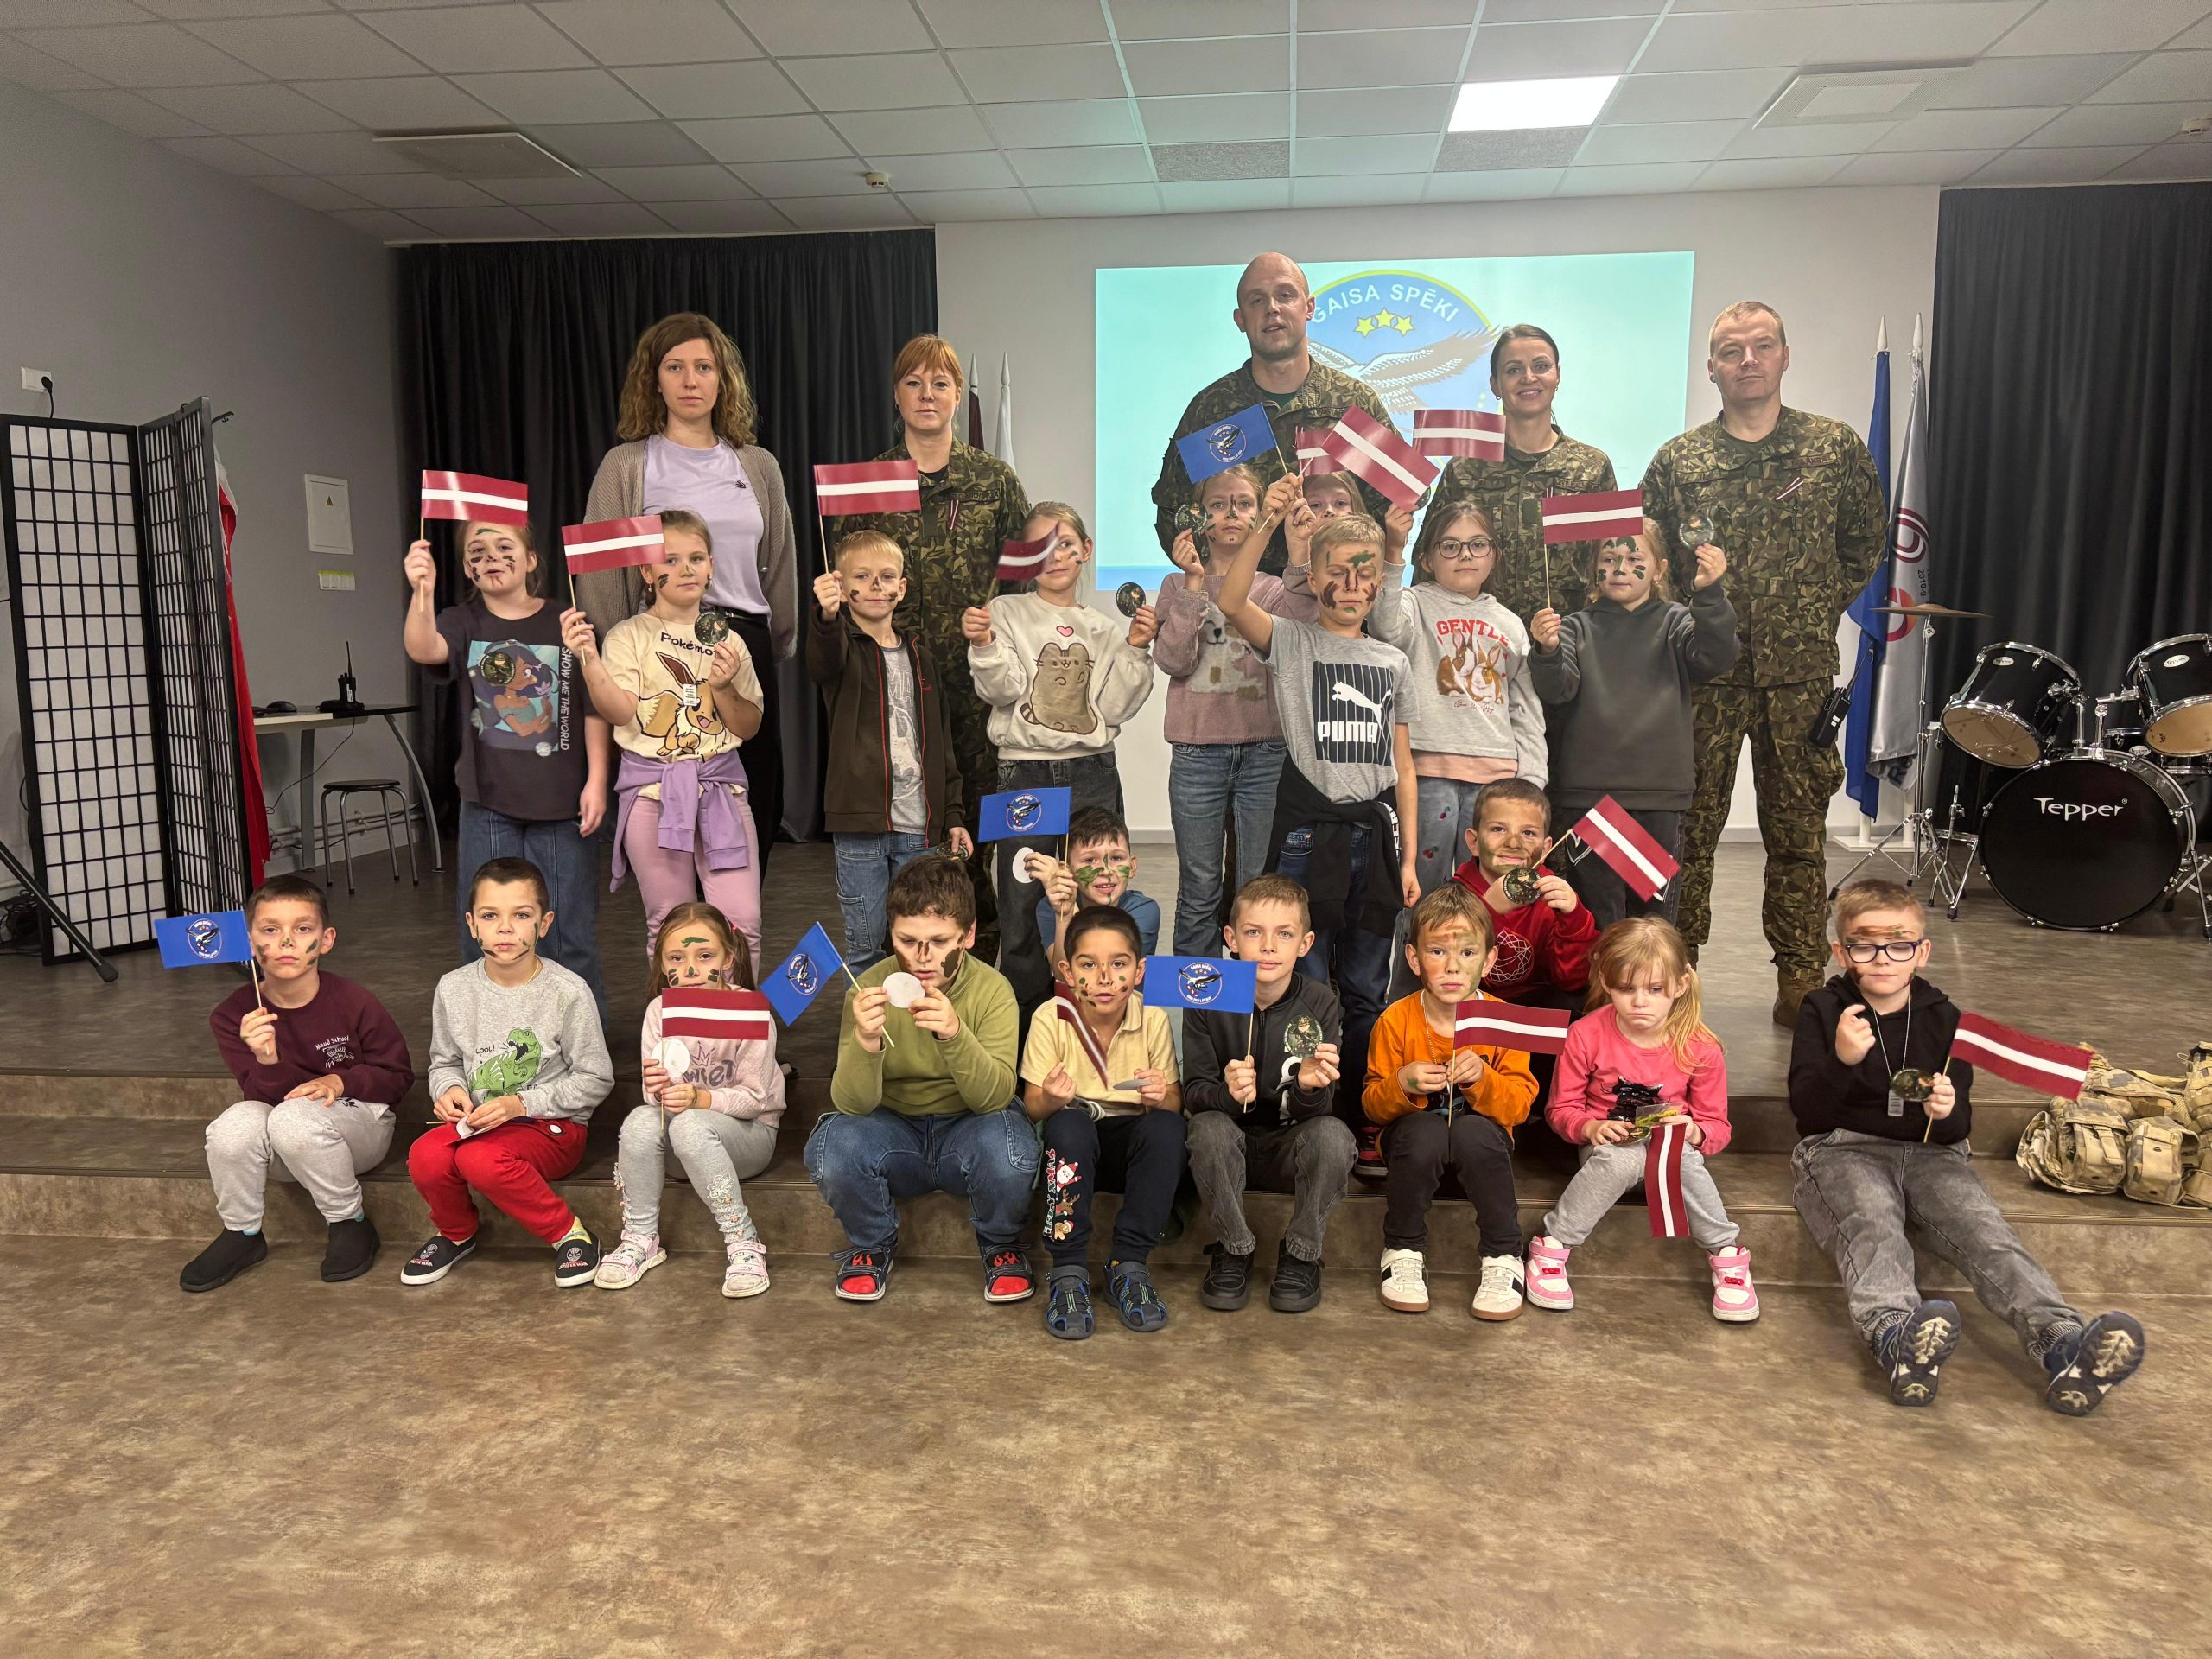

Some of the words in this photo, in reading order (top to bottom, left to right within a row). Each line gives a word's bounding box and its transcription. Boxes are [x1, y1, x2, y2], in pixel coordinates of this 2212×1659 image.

[1312, 284, 1381, 323] GAISA
[1389, 283, 1459, 322] SPĒKI
[561, 646, 572, 679] SHOW
[561, 679, 570, 696] ME
[560, 696, 570, 715] THE
[560, 715, 570, 751] WORLD
[1317, 721, 1379, 744] PUMA
[2032, 797, 2125, 822] Tepper
